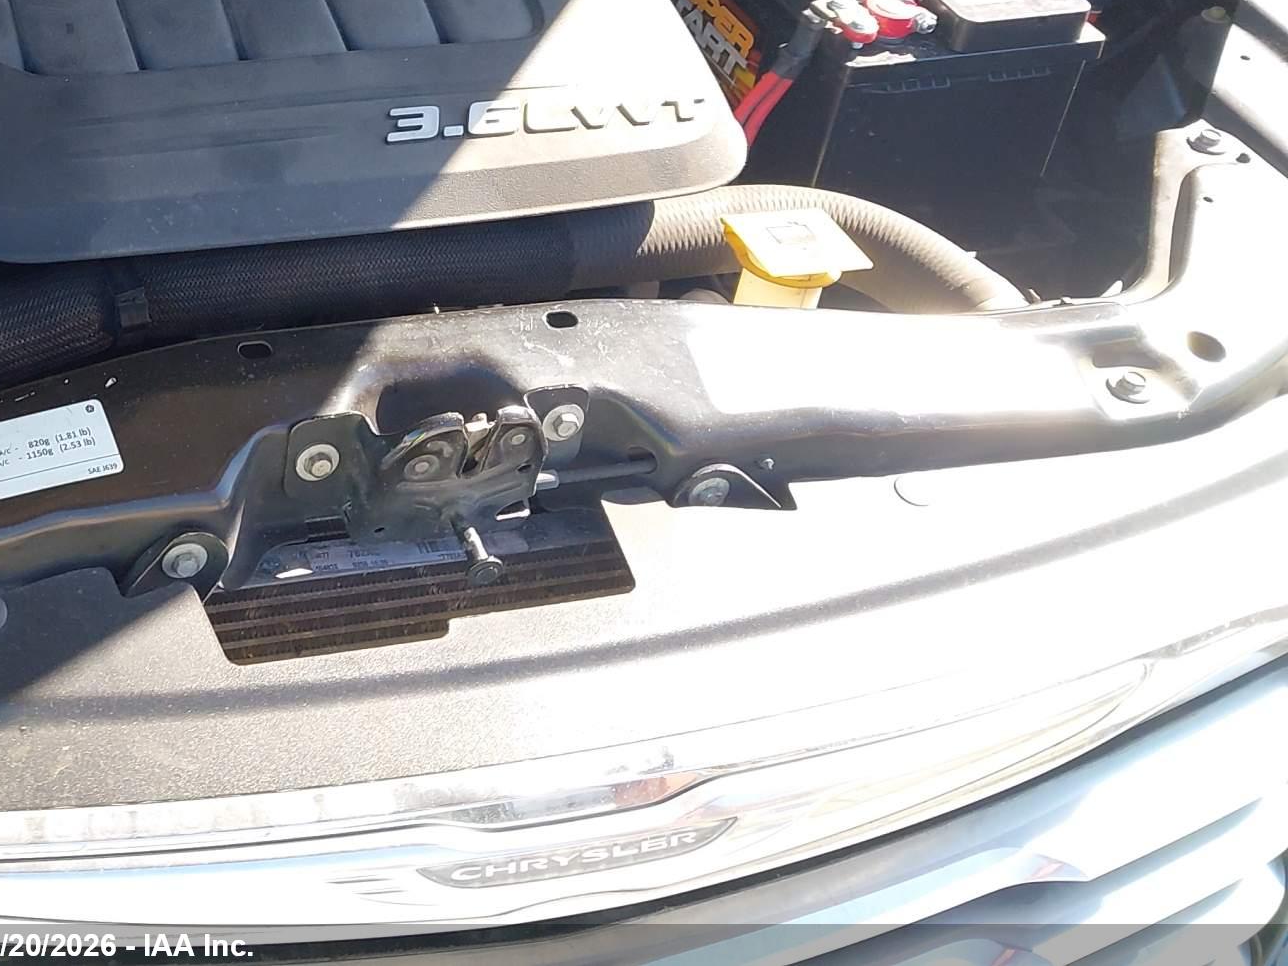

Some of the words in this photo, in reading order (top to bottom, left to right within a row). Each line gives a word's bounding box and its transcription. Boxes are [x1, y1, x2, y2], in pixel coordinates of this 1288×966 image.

[0, 447, 12, 458] A/C
[28, 438, 50, 449] 820g
[55, 431, 77, 443] (1.81
[78, 426, 91, 437] lb)
[26, 447, 54, 460] 1150g
[59, 441, 82, 453] (2.53
[83, 436, 96, 447] lb)
[87, 465, 101, 475] SAE
[450, 830, 697, 881] CHRYSLER
